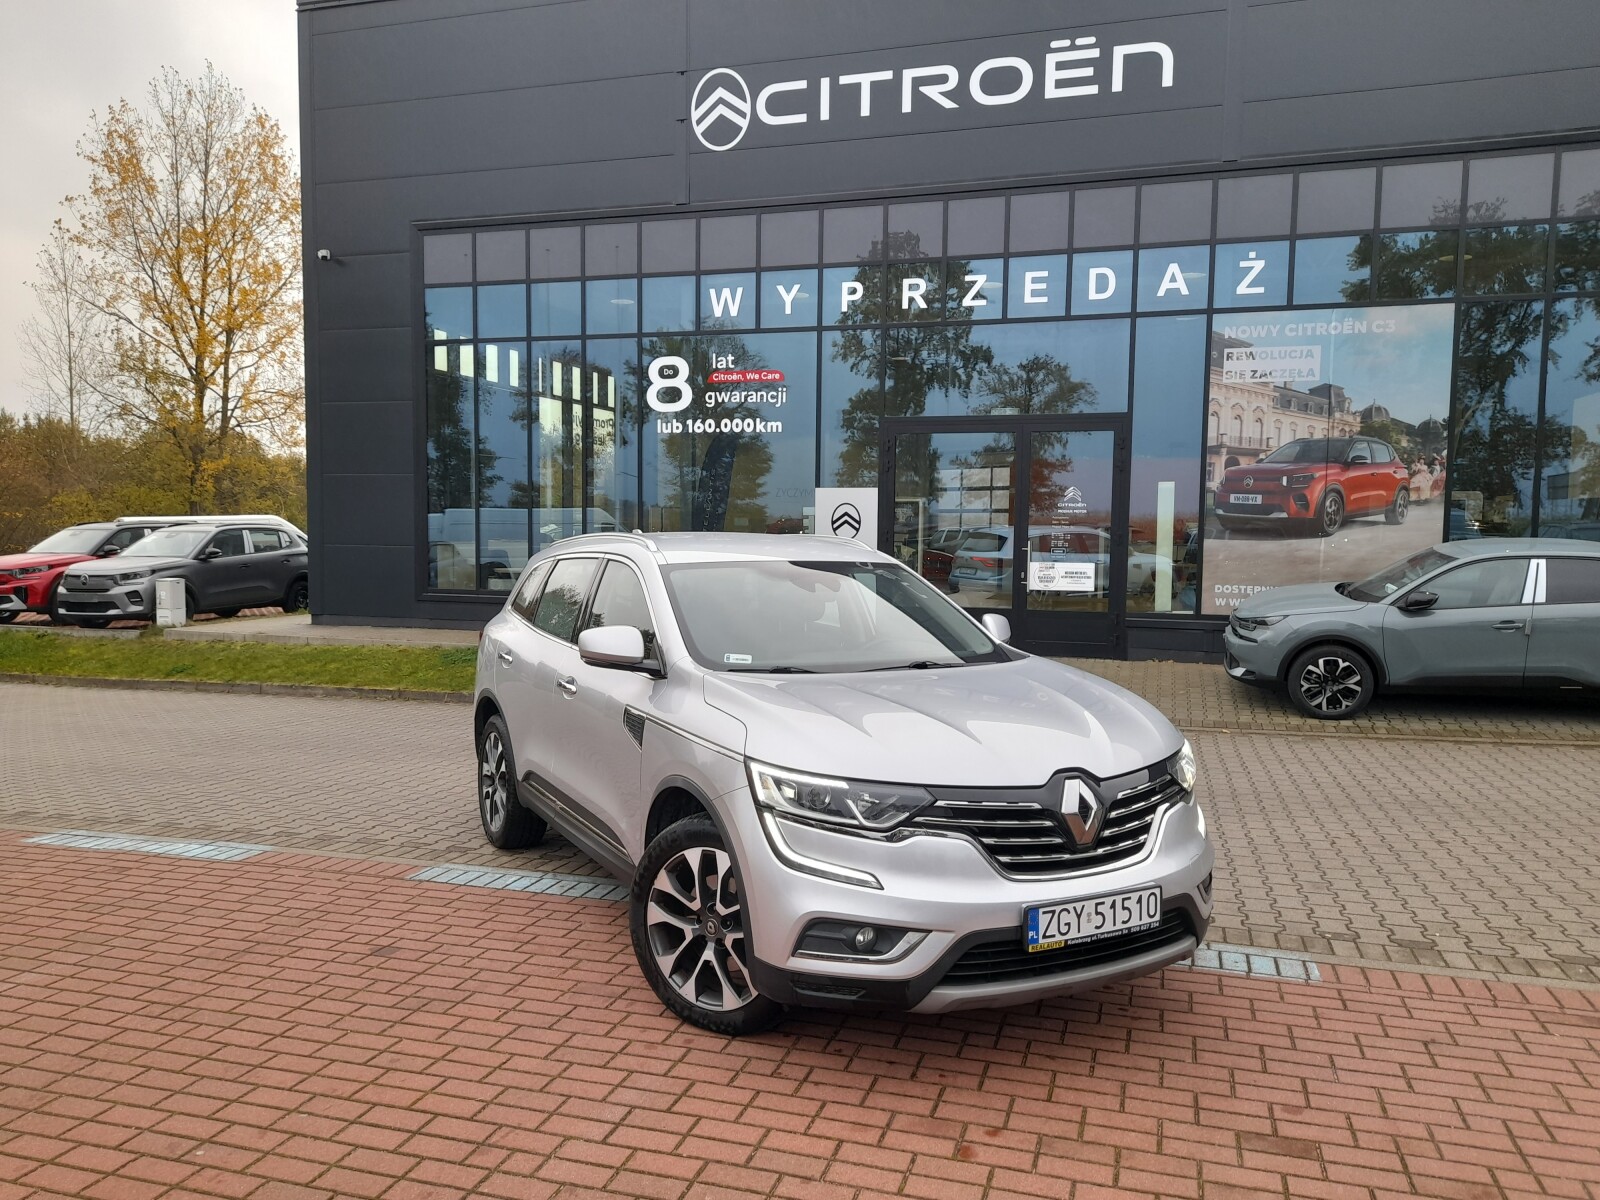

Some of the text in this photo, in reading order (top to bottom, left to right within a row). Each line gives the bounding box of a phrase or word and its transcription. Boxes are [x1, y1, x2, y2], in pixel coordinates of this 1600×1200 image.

[755, 36, 1175, 126] CITROËN
[1224, 318, 1396, 339] NOWY CITROËN C3
[712, 353, 735, 369] lat
[1225, 348, 1315, 362] REWOLUCJA
[646, 355, 693, 413] 8
[712, 372, 780, 381] Citroën, We Care
[705, 387, 787, 408] gwarancji
[657, 419, 683, 434] lub
[1214, 584, 1279, 596] DOSTĘP
[1215, 597, 1226, 606] W
[1041, 891, 1158, 940] ZGY 51510
[1028, 930, 1038, 939] PL
[1030, 941, 1063, 952] REALAUTO
